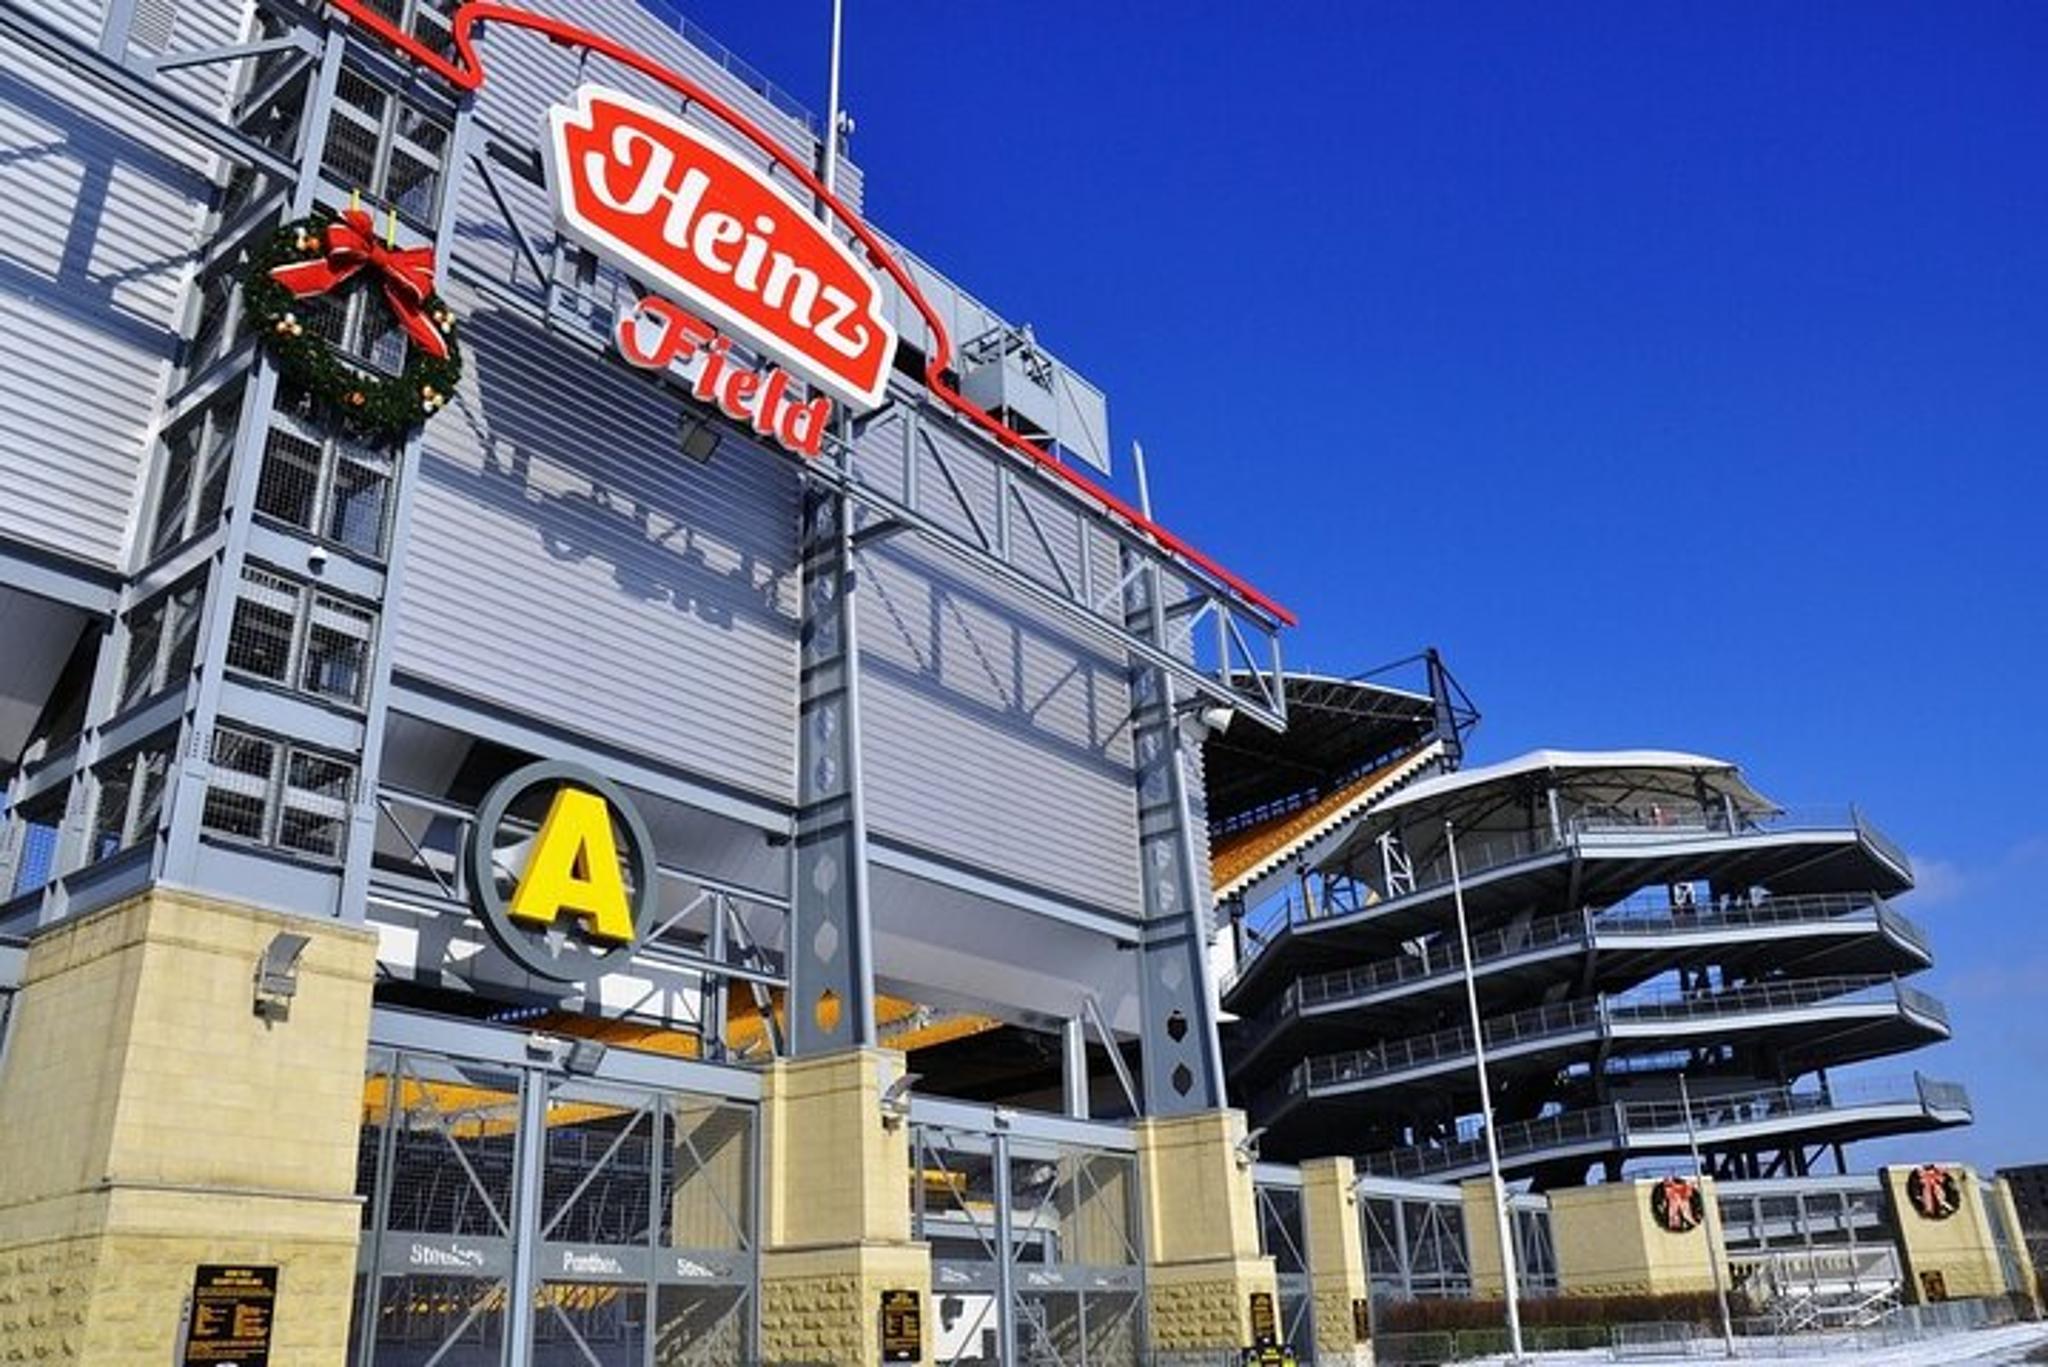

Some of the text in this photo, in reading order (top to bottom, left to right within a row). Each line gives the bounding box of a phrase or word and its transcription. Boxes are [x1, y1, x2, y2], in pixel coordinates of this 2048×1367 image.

[583, 125, 870, 360] Heinz
[615, 296, 832, 458] Field
[507, 788, 636, 943] A
